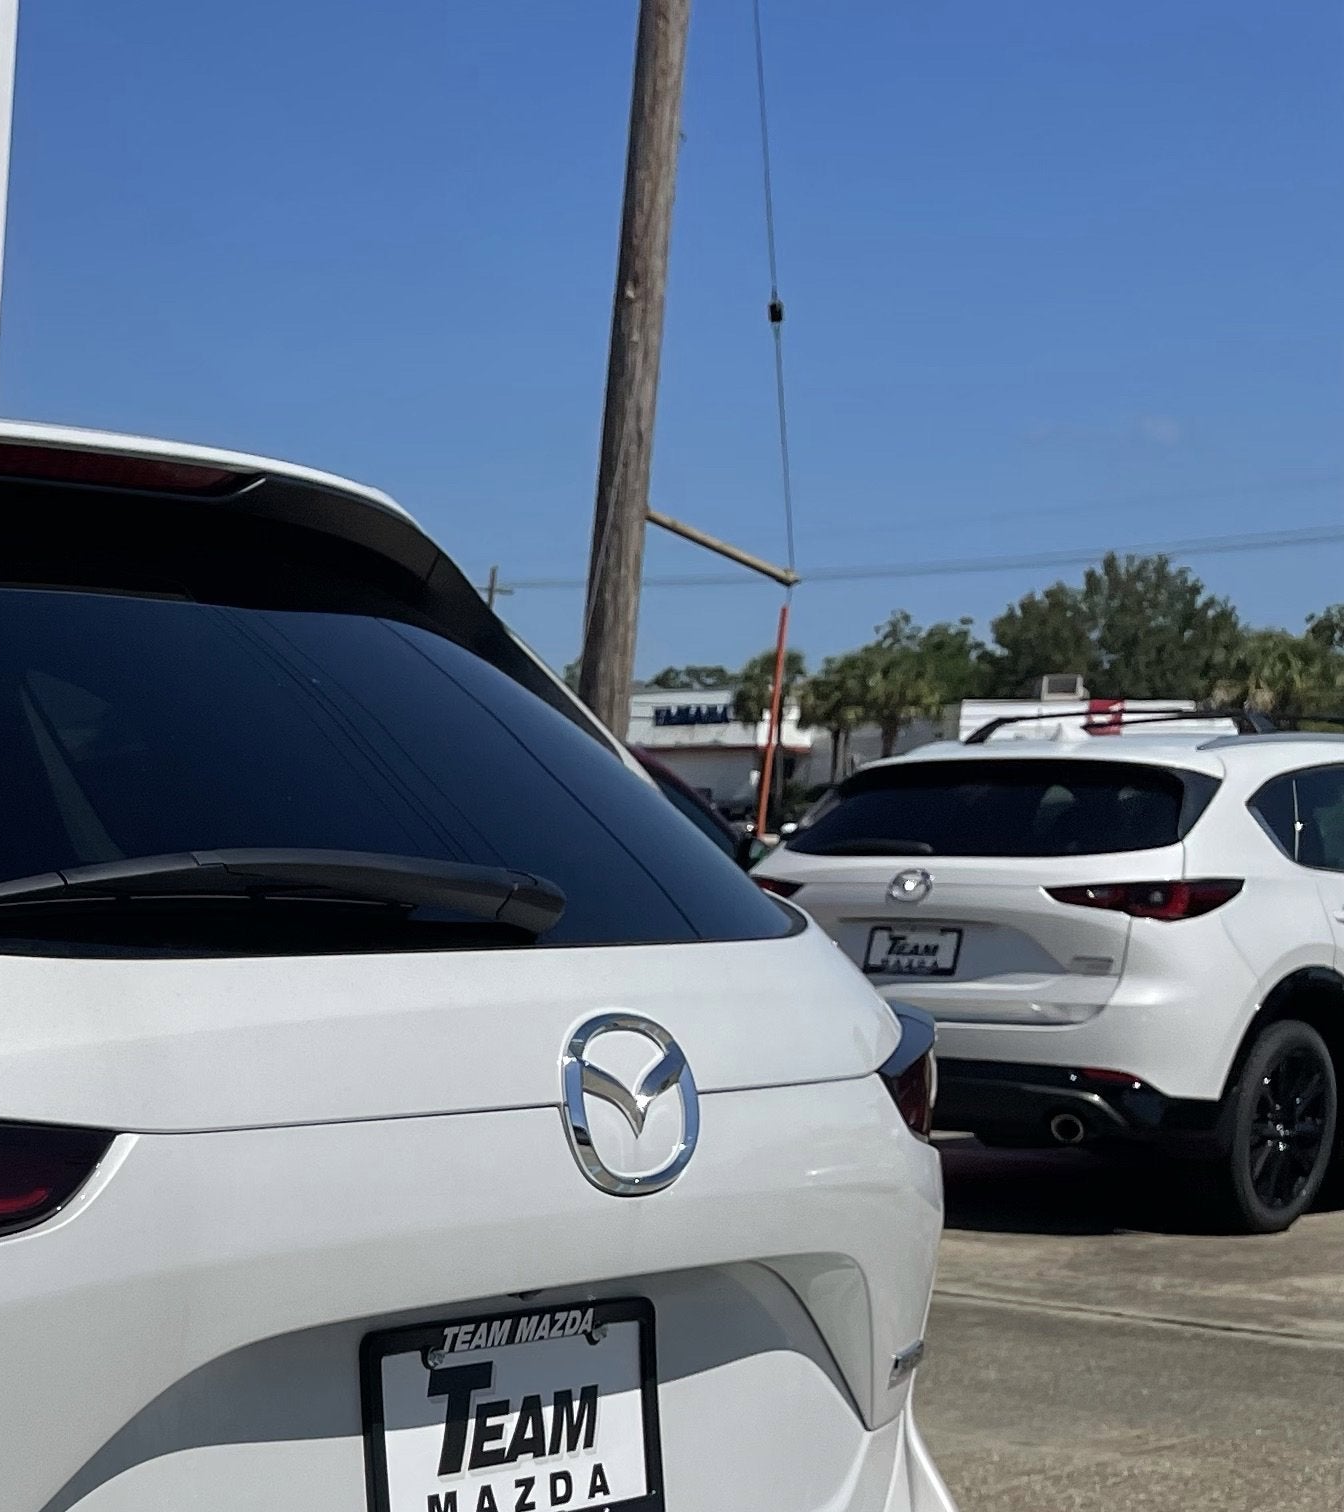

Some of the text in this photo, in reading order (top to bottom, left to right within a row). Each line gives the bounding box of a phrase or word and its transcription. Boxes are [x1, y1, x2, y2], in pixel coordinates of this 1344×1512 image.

[888, 935, 939, 957] TEAM
[443, 1307, 595, 1353] TEAM MAZDA
[426, 1360, 600, 1477] TEAM
